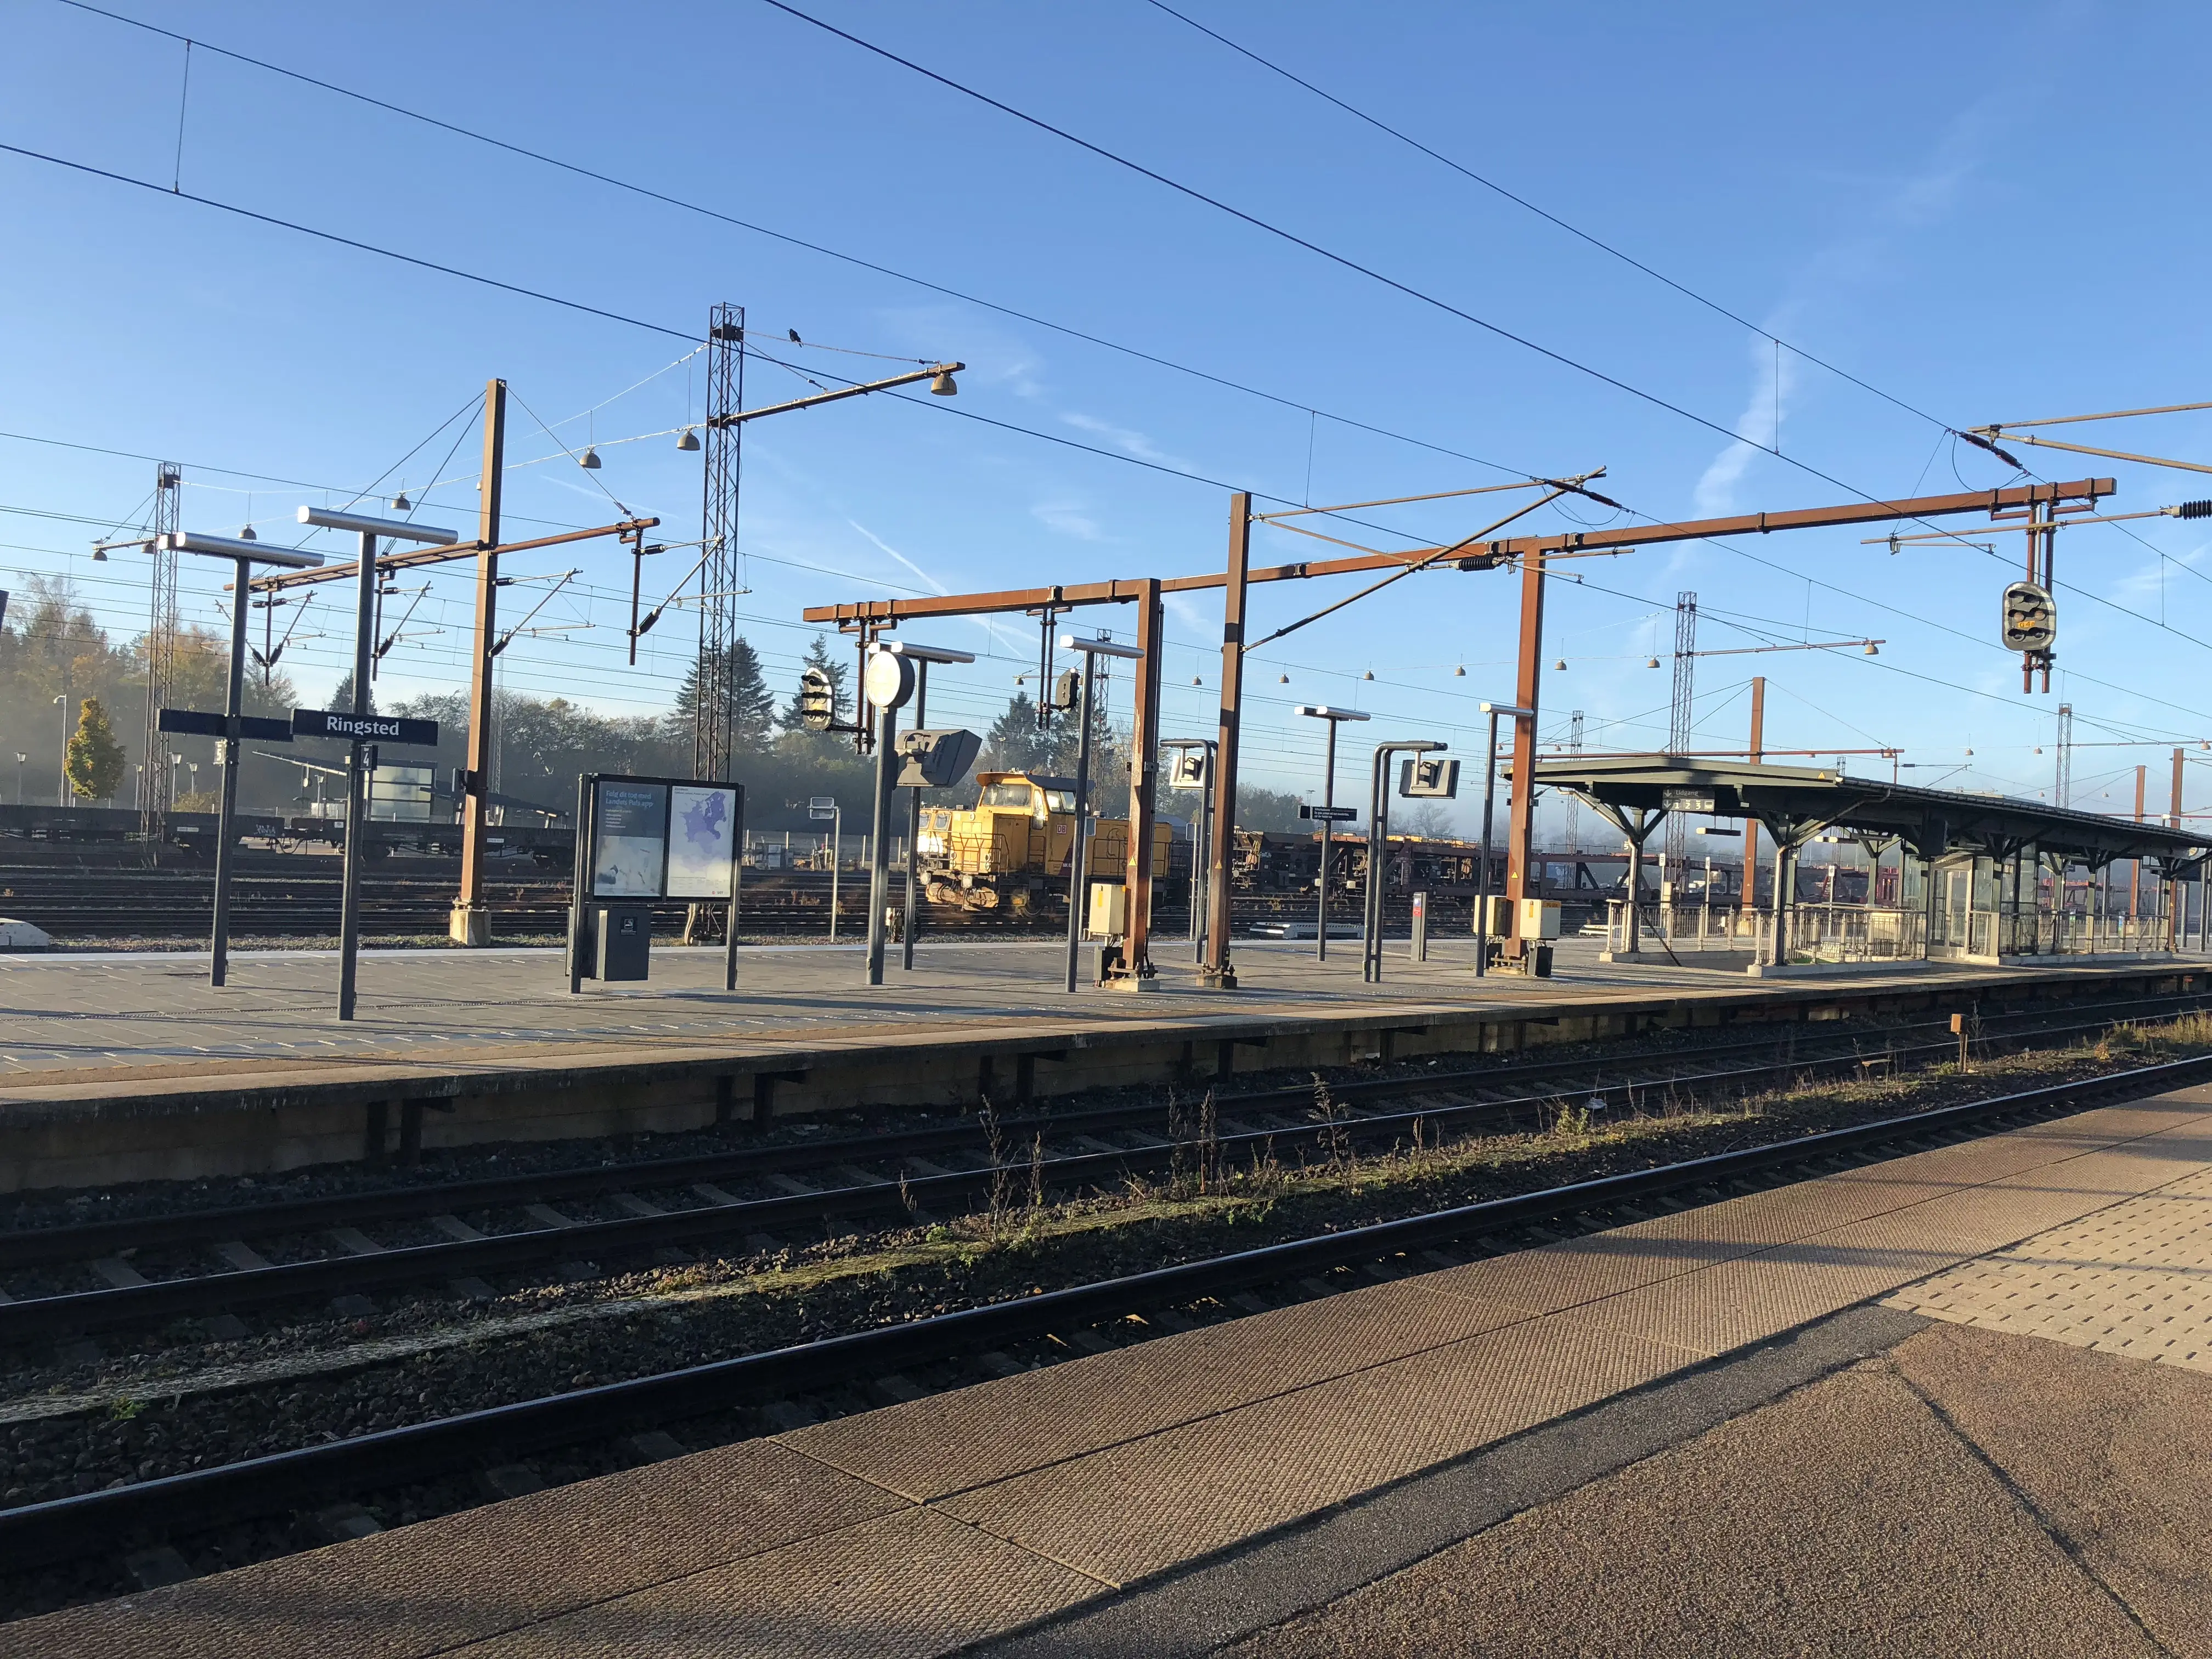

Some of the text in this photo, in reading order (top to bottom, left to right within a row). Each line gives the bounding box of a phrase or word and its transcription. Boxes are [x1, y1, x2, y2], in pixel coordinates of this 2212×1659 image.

[326, 716, 399, 736] Ringsted
[217, 748, 222, 761] 5
[363, 752, 369, 766] 4
